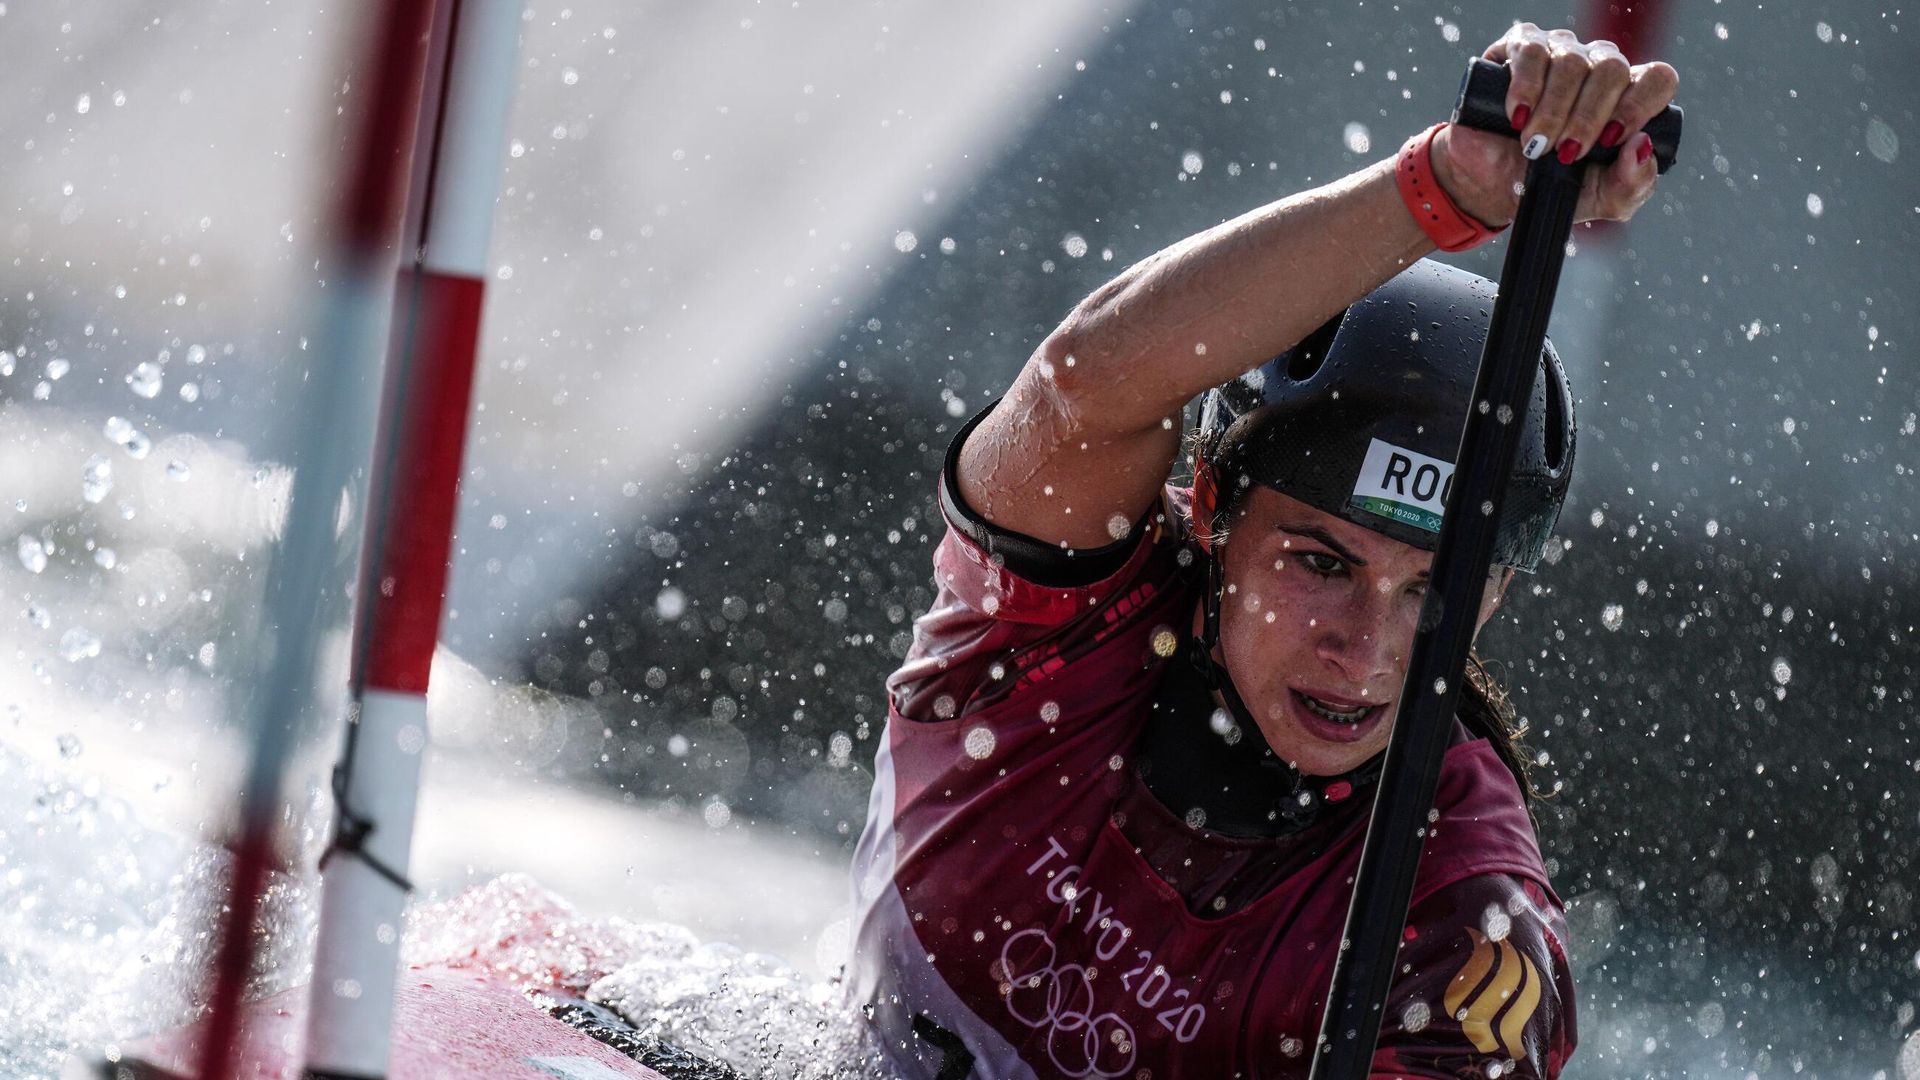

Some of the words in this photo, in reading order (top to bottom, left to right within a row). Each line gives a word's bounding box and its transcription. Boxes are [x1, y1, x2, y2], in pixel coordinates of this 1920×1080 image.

[1379, 503, 1402, 516] TOKYO
[1402, 510, 1421, 522] 2020
[1120, 950, 1206, 1043] 2020
